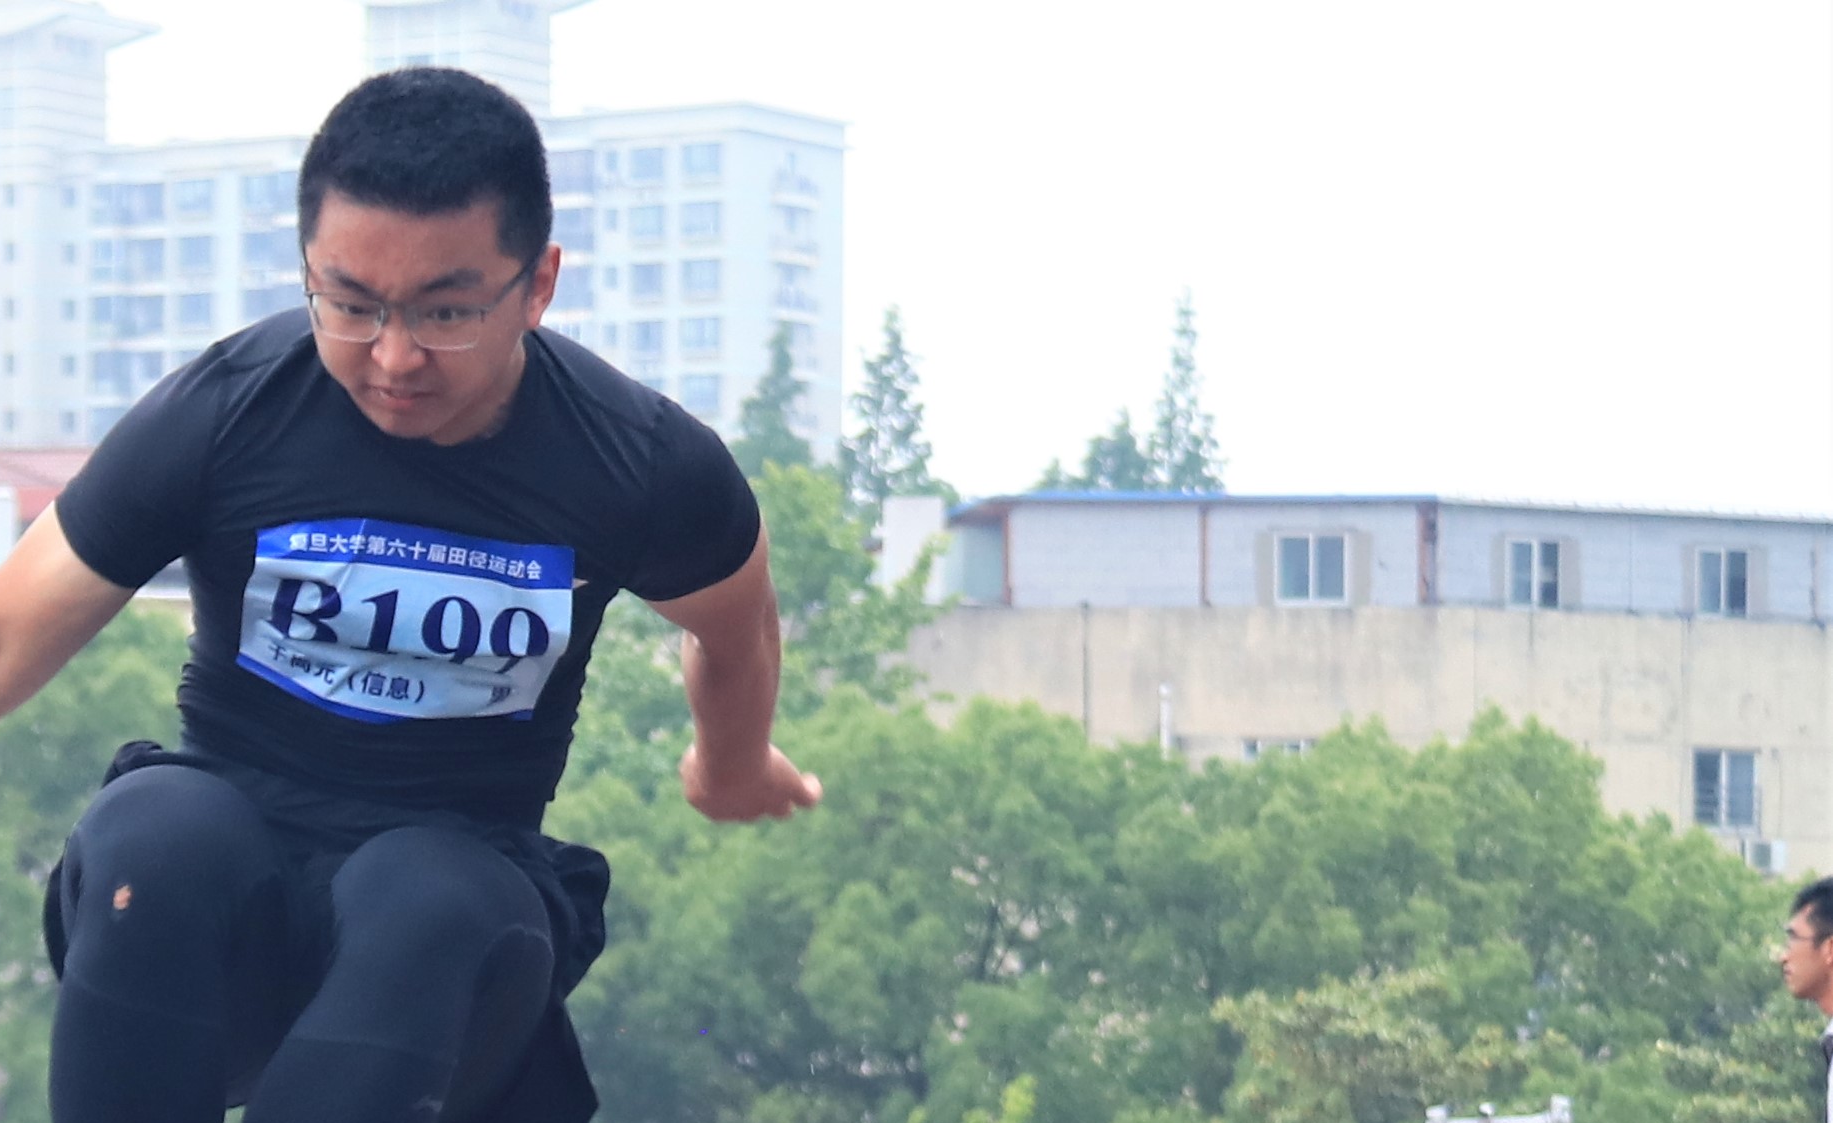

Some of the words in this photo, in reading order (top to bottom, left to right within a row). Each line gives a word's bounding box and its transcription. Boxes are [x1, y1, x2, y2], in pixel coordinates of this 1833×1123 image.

[288, 532, 543, 580] 复旦大学第六十届田径运动会
